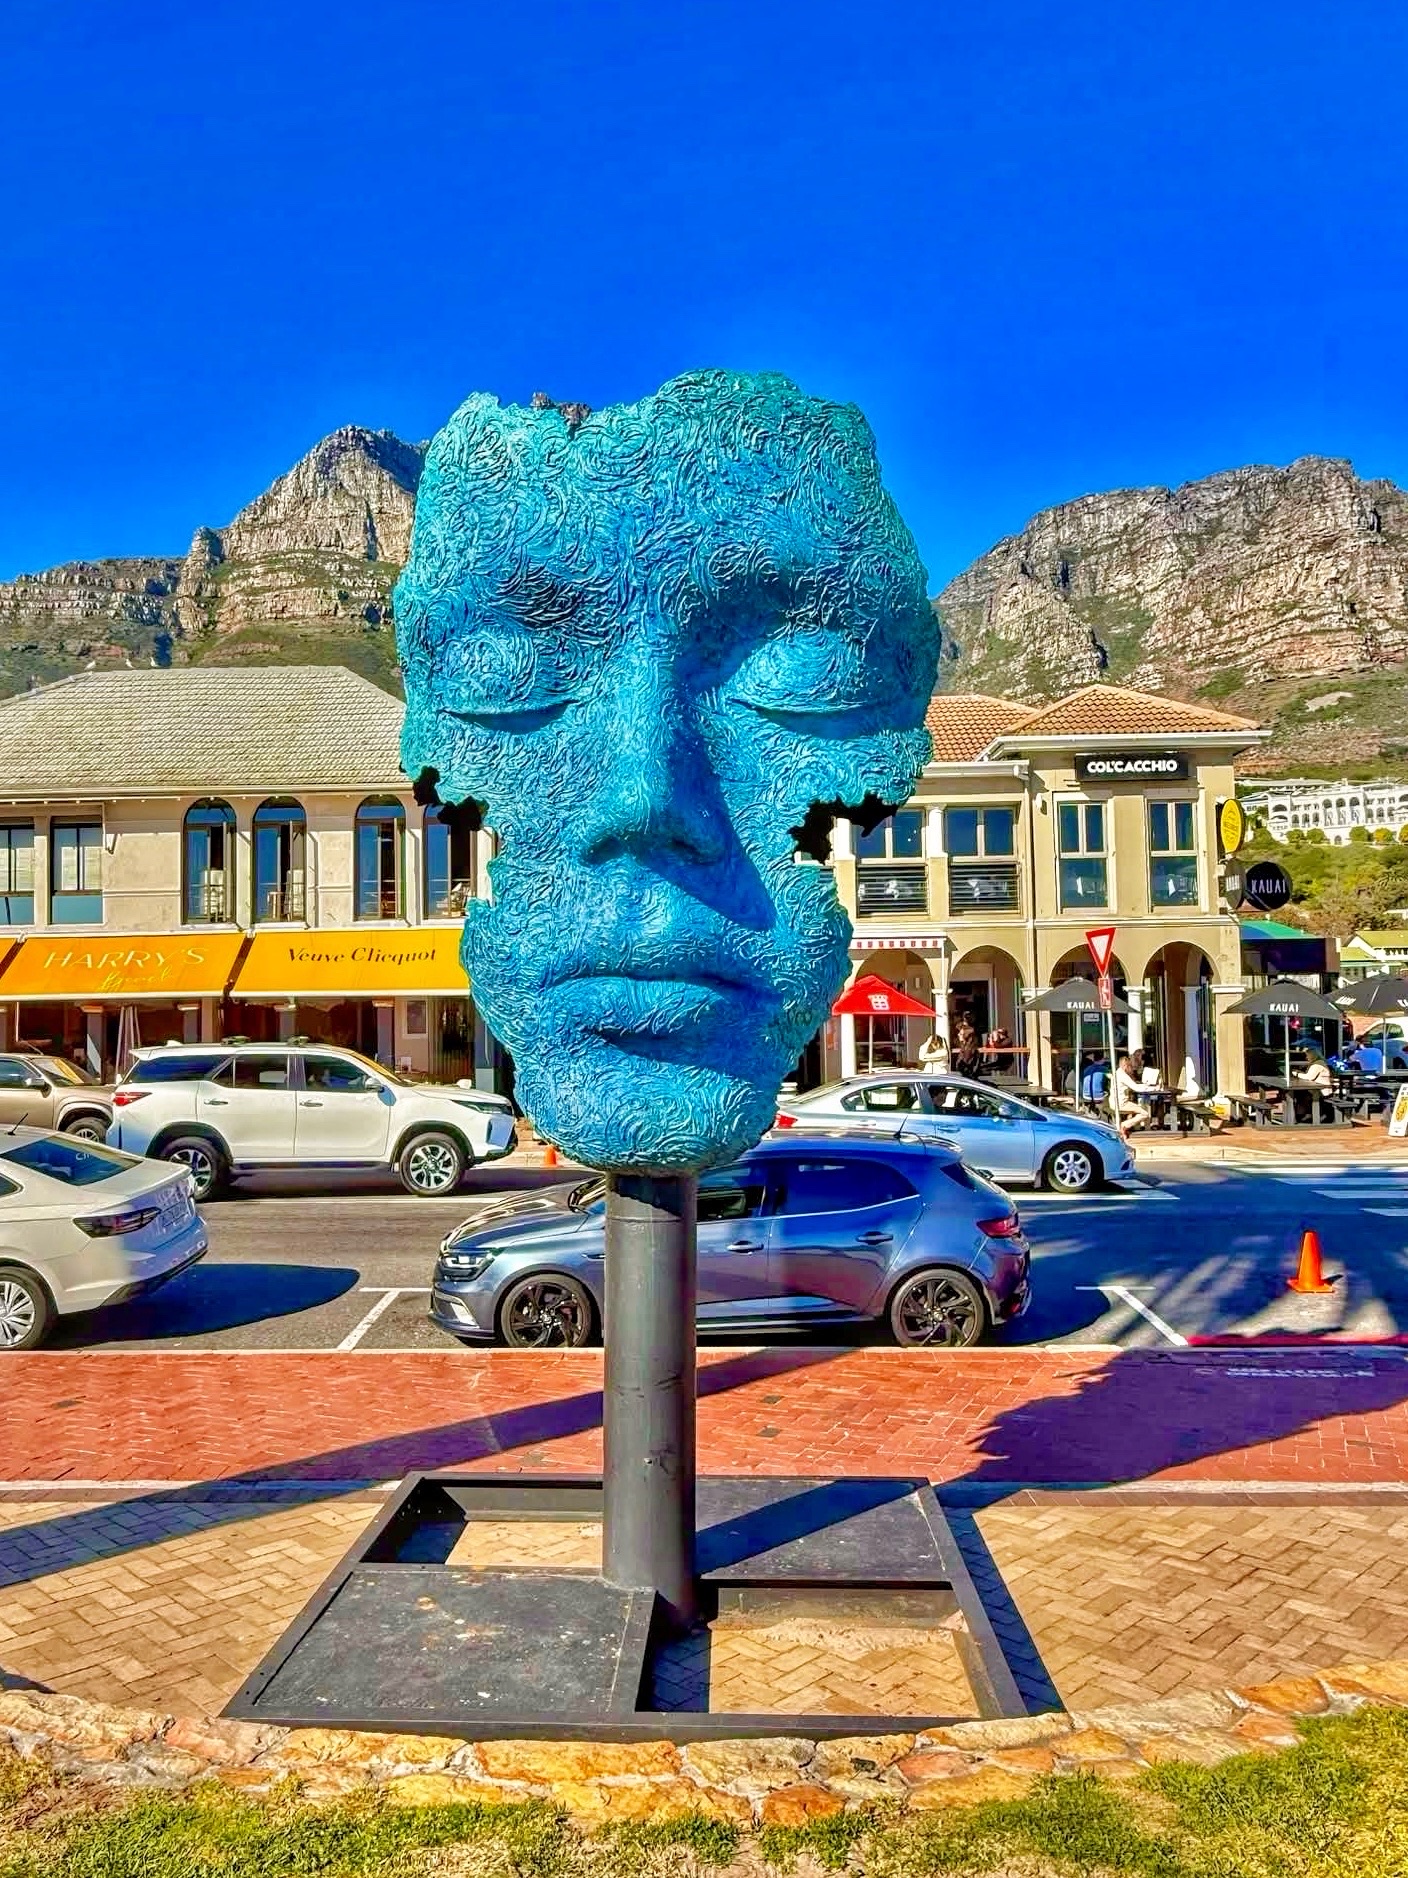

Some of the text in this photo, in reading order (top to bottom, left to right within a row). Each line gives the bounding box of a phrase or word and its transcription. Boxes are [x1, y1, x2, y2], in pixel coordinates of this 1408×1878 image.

[1087, 760, 1178, 773] COL'CACCHIO
[1251, 879, 1287, 894] KAUAI
[44, 948, 207, 968] HARRY'S
[289, 948, 436, 965] Veuve Clicquot
[1269, 1003, 1299, 1013] KAUAI
